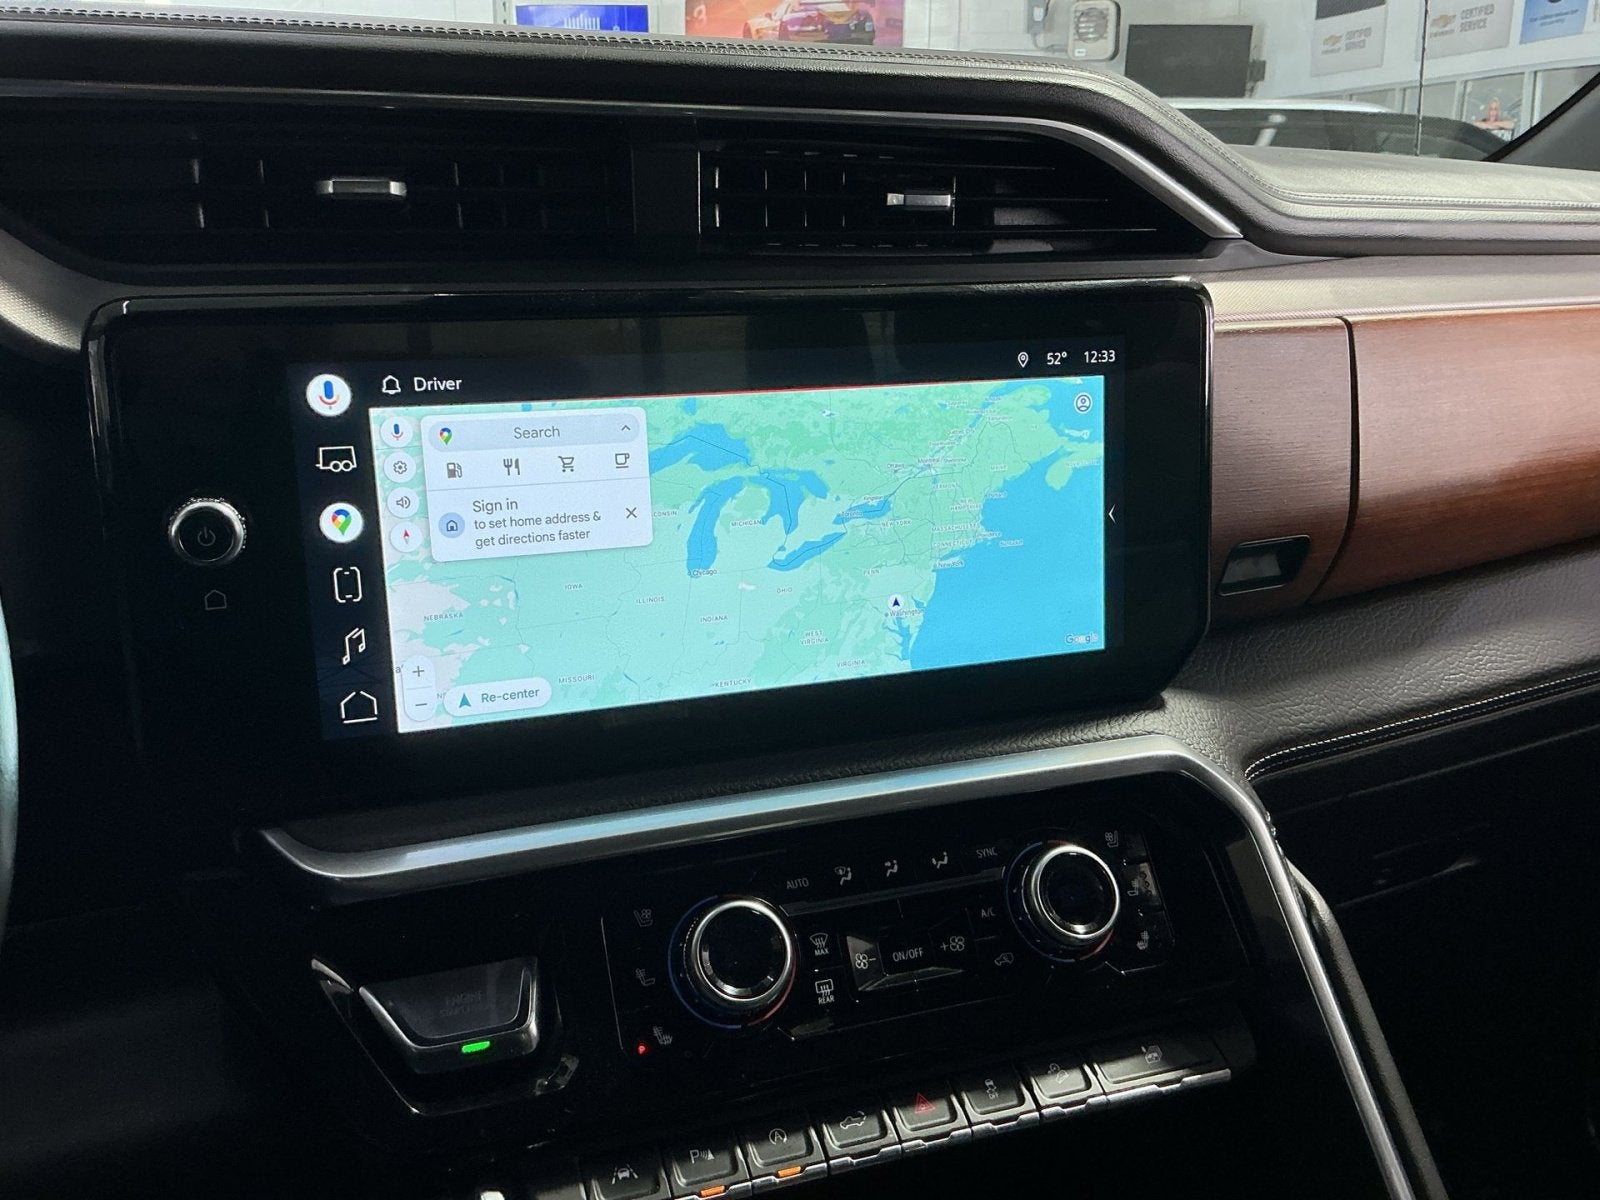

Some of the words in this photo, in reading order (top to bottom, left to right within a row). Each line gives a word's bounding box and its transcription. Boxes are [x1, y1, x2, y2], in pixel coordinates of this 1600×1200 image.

[1083, 351, 1116, 363] 12:33
[413, 377, 462, 392] Driver
[513, 426, 561, 440] Search
[472, 500, 503, 516] Sign
[506, 498, 519, 511] in
[474, 518, 487, 530] to
[488, 517, 508, 529] set
[510, 514, 543, 527] home
[545, 512, 591, 526] address
[592, 511, 602, 522] &
[730, 519, 763, 528] MICHIGAN
[475, 536, 496, 549] get
[497, 531, 556, 546] directions
[557, 528, 591, 542] faster
[692, 568, 718, 578] Chicago
[636, 596, 665, 604] ILLINOIS
[423, 612, 464, 622] NEBRASKA
[700, 615, 729, 623] INDIANA
[1065, 633, 1099, 645] Google
[836, 659, 866, 668] VIRGINIA
[558, 674, 596, 684] MISSOURI
[714, 678, 752, 688] KENTUCKY
[481, 687, 540, 703] Re-center
[976, 847, 998, 859] SYNC
[786, 878, 809, 889] AUTO
[980, 907, 997, 919] A/C
[814, 947, 829, 956] MAX
[892, 947, 924, 962] ON/OFF
[818, 995, 835, 1005] REAR
